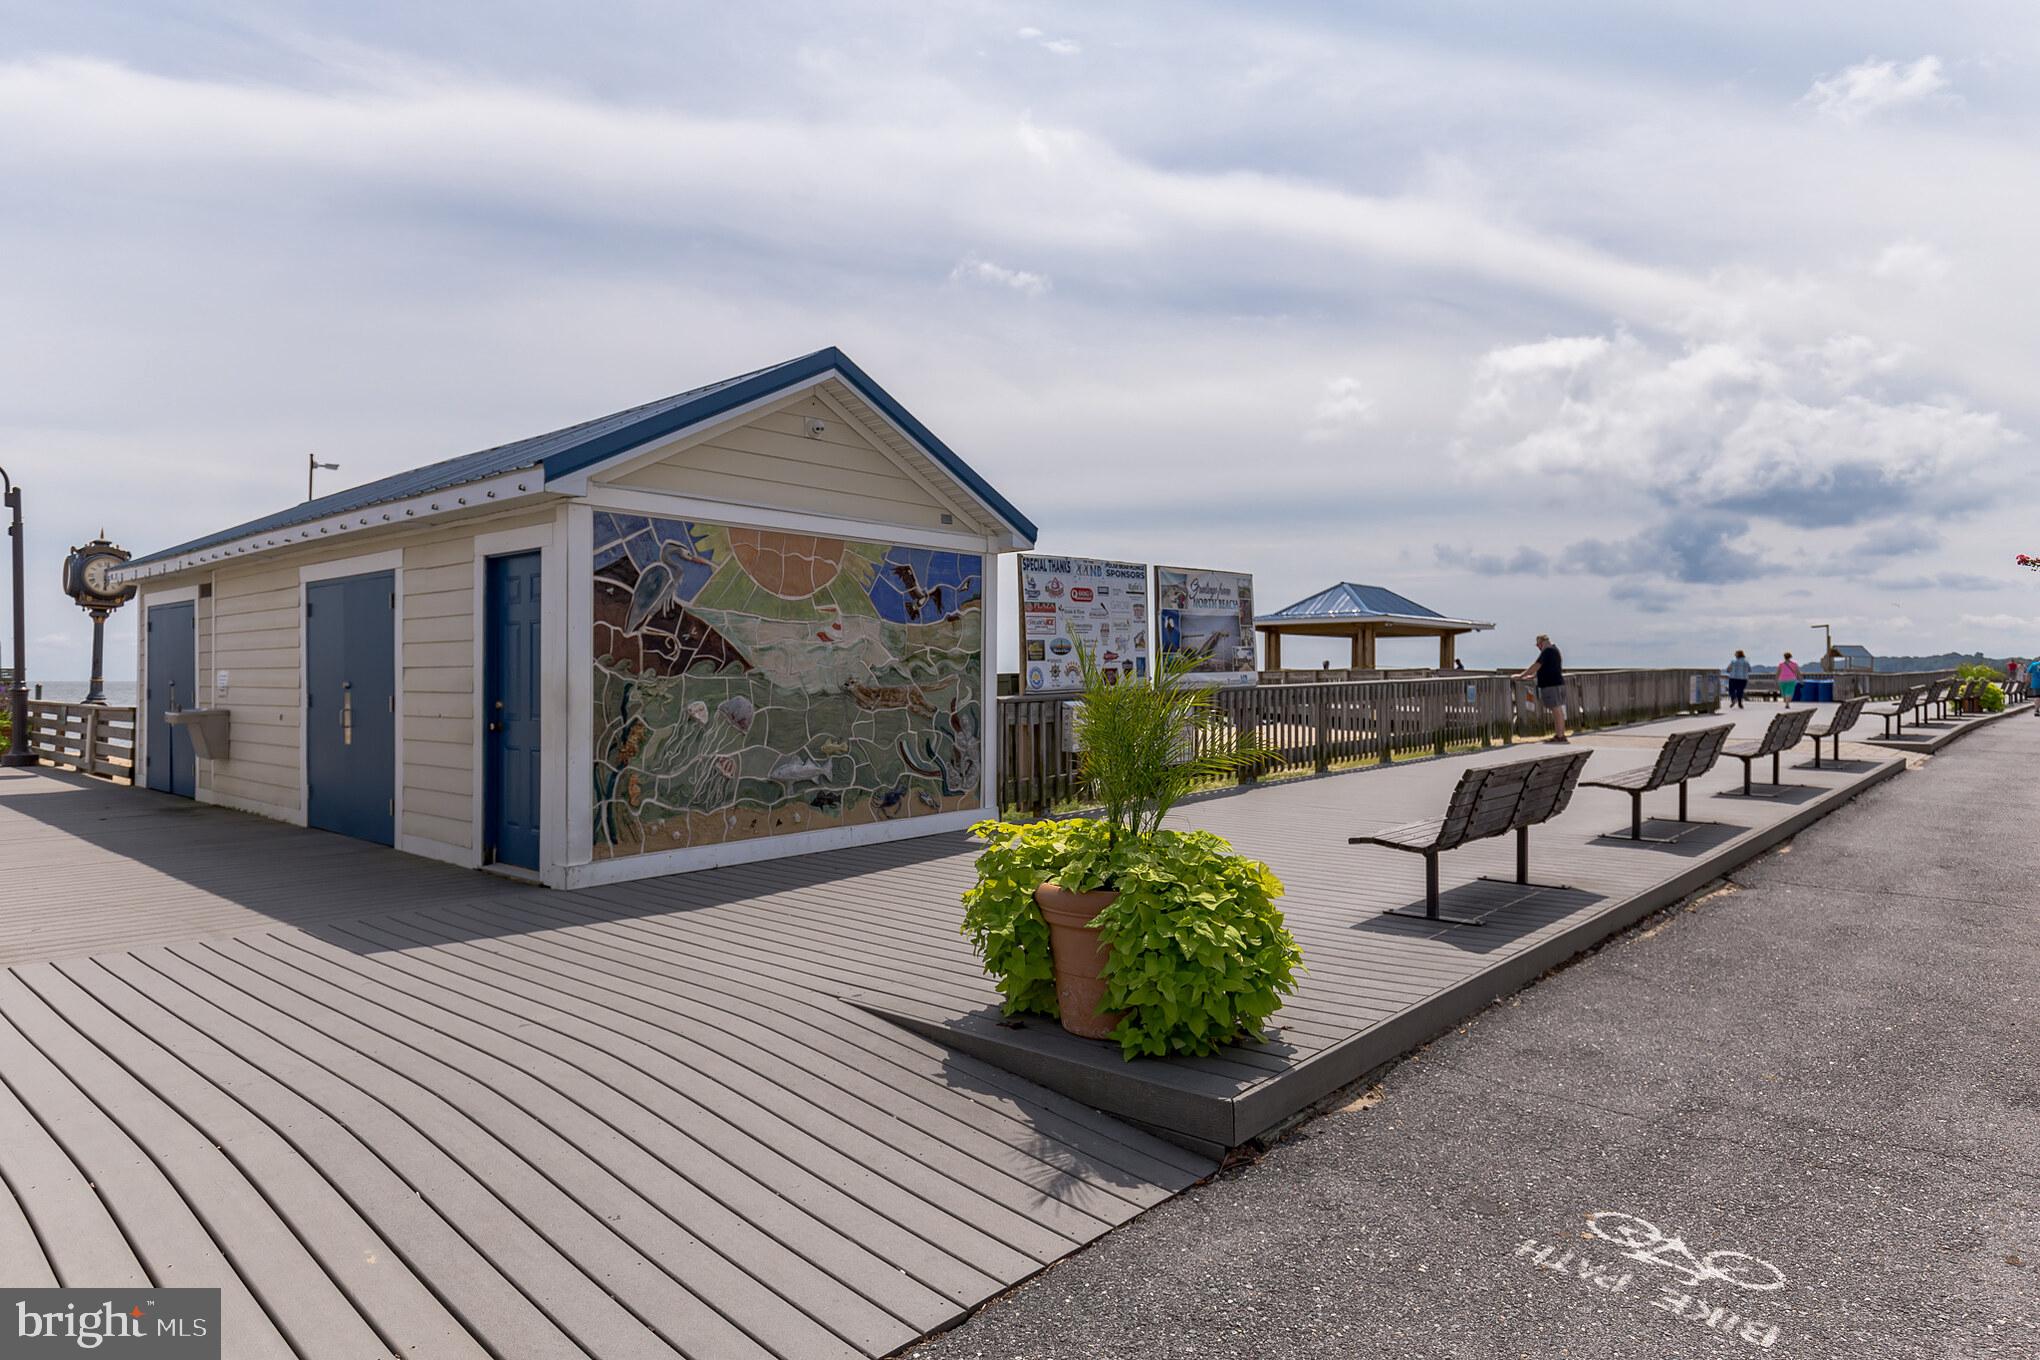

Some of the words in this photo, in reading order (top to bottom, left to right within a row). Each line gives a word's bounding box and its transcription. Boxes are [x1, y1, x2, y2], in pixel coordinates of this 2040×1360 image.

[1023, 558, 1047, 572] SPECIAL
[1048, 559, 1071, 573] THANKS
[1105, 569, 1145, 579] SPONSORS
[1193, 598, 1217, 608] NORTH
[1218, 599, 1238, 609] BEACH
[1650, 1287, 1780, 1348] BIKE
